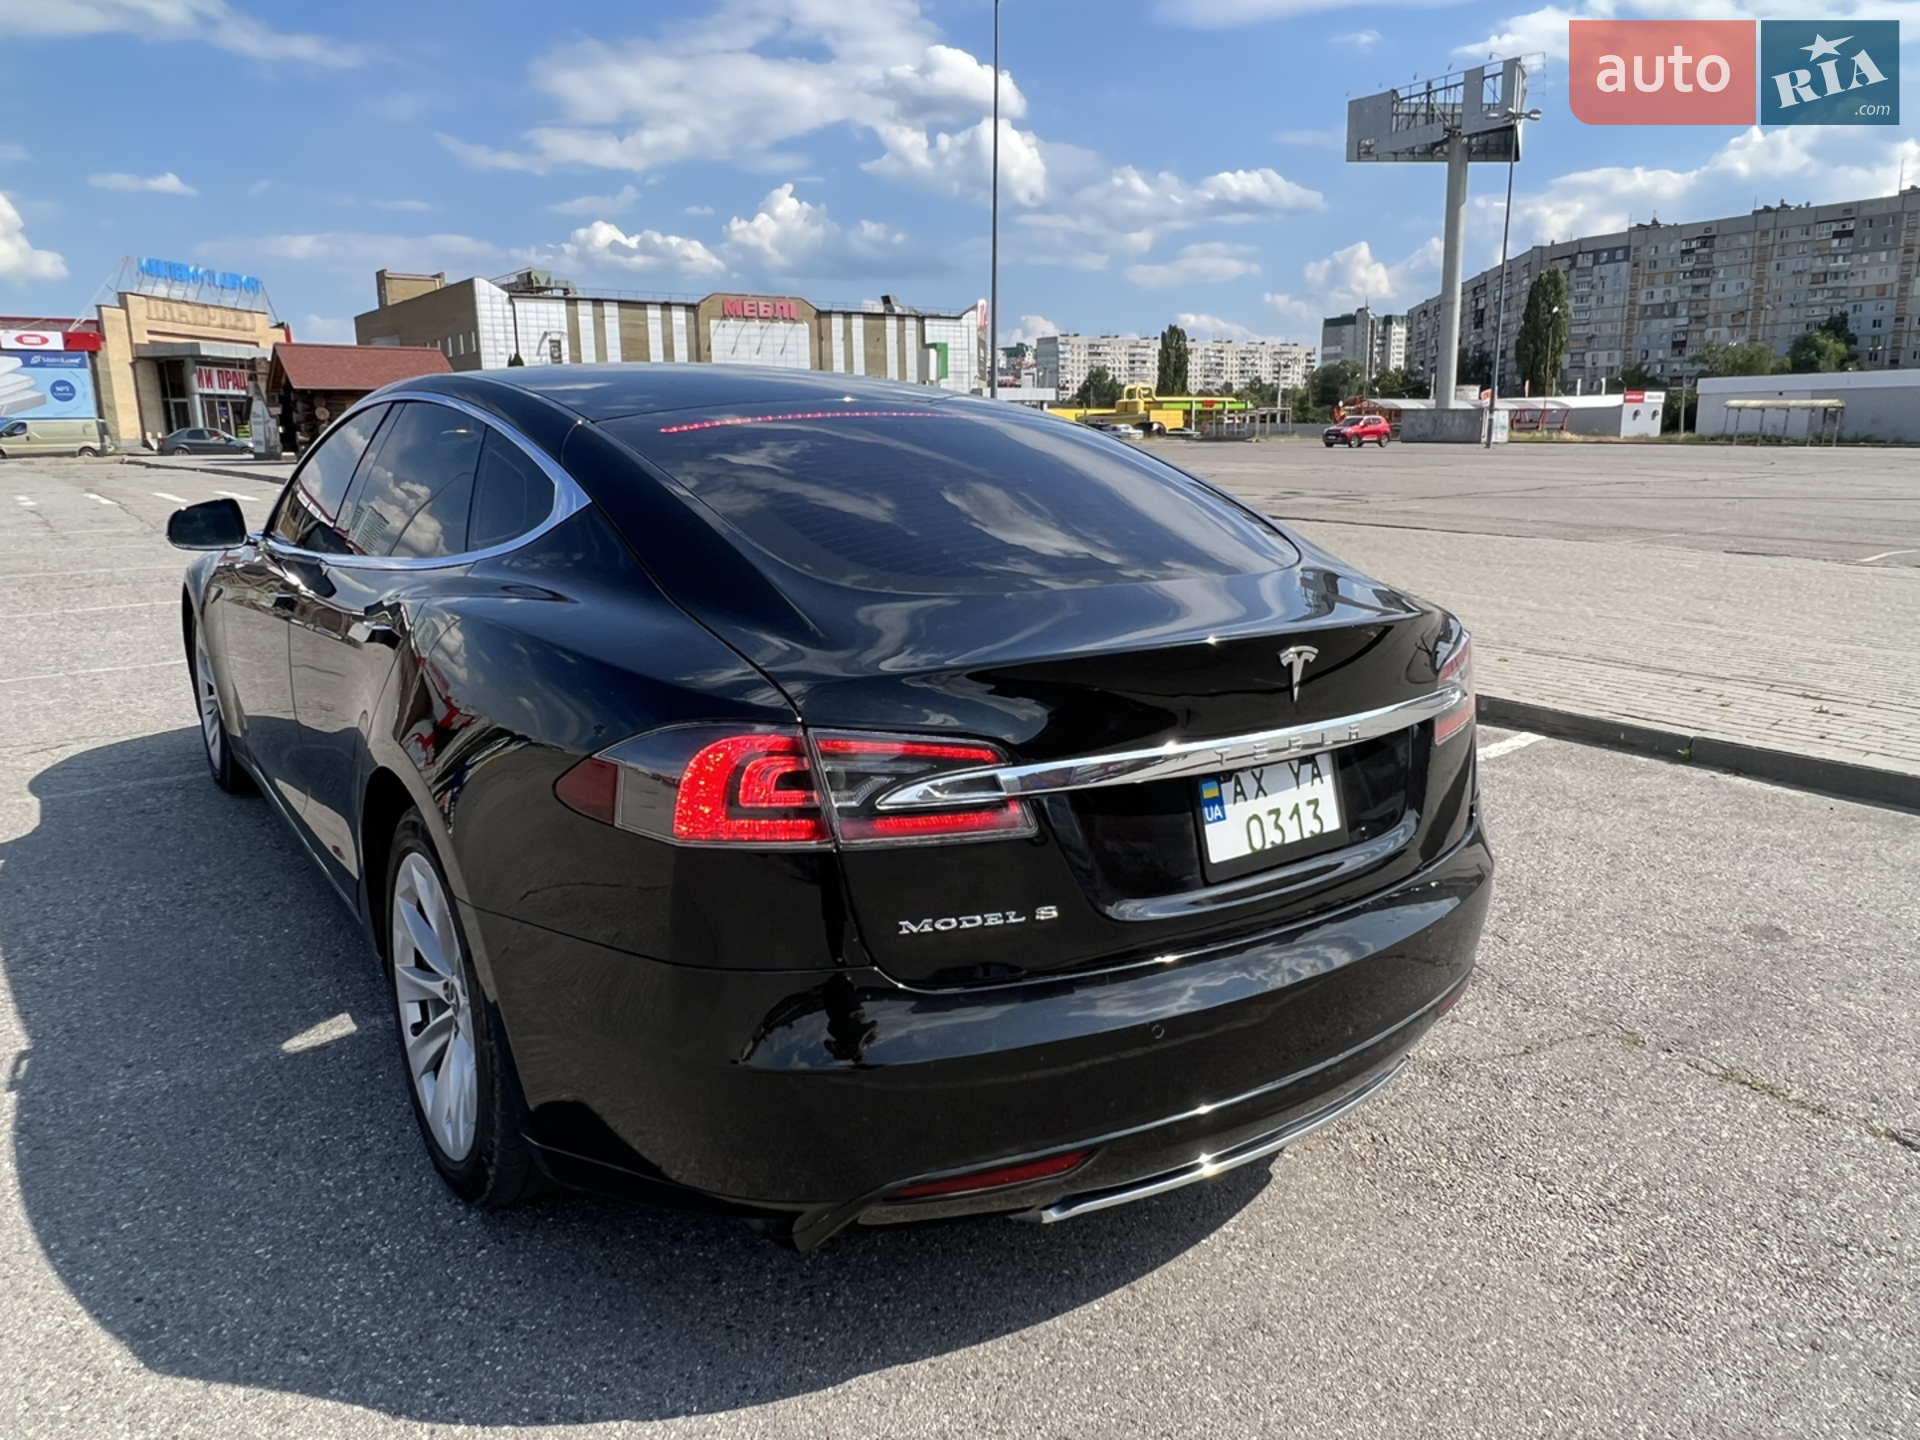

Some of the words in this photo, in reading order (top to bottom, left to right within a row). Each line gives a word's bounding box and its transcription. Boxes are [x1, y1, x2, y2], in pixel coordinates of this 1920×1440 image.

[722, 298, 798, 320] МЕБЛІ
[1215, 723, 1360, 766] TESLA
[1233, 768, 1268, 805] AX
[1288, 755, 1324, 789] YA
[1205, 804, 1223, 822] UA
[1245, 797, 1325, 853] 0313
[898, 911, 1026, 935] MODEL
[1035, 905, 1059, 921] S
